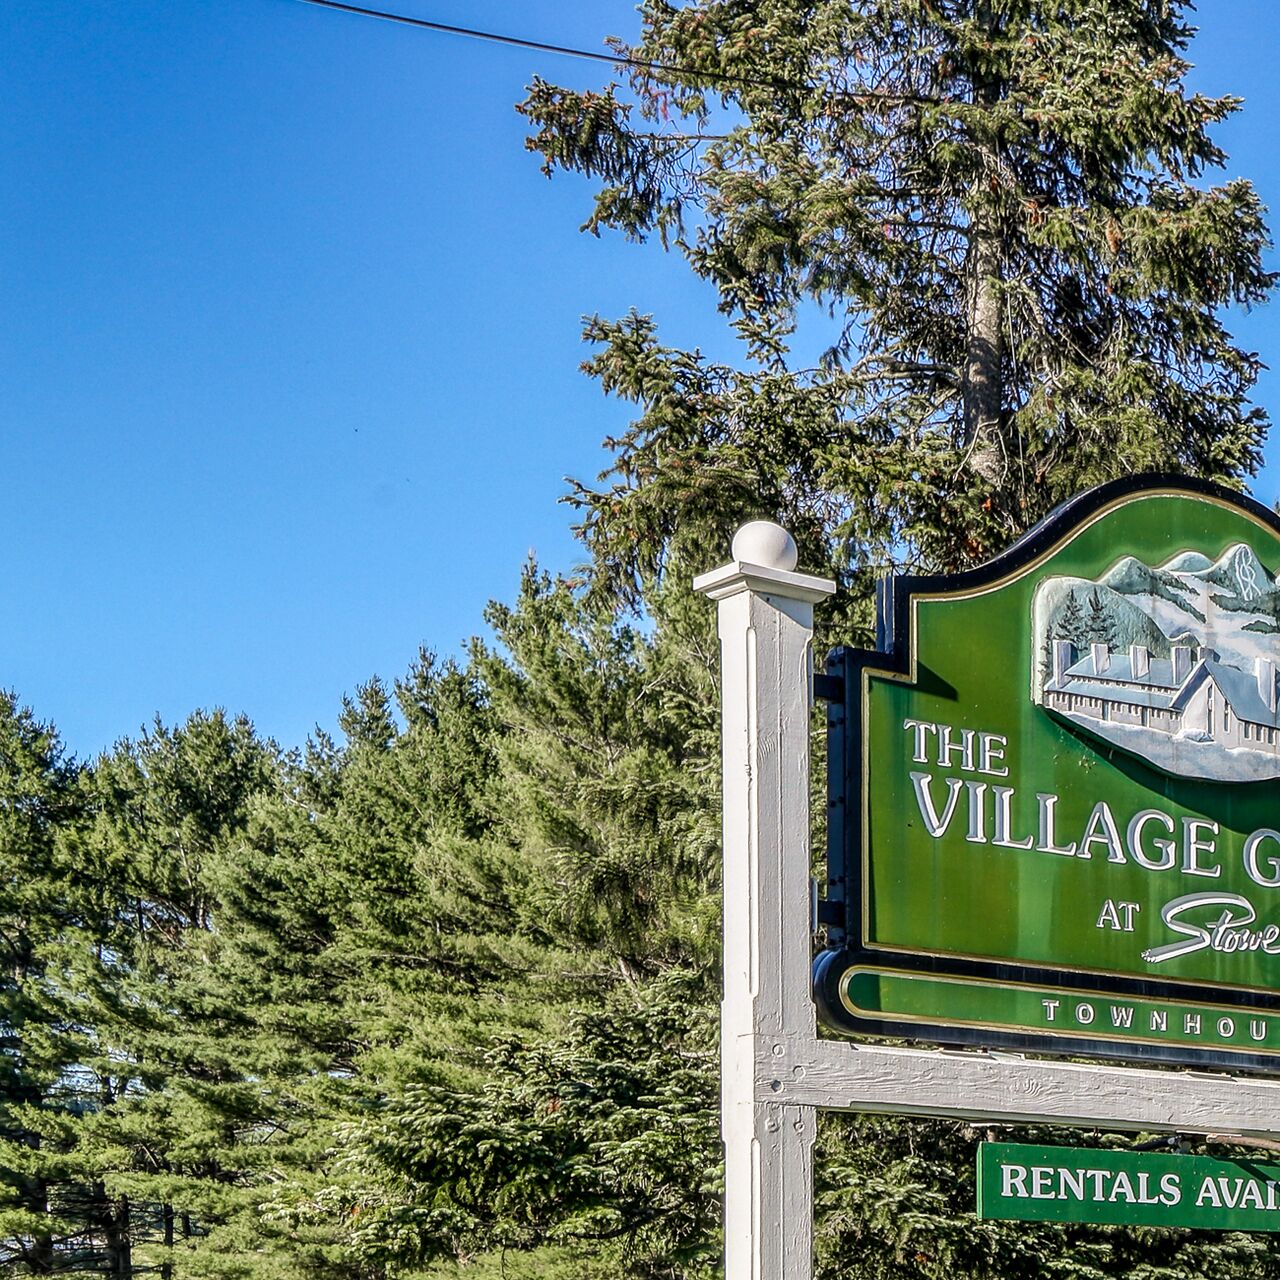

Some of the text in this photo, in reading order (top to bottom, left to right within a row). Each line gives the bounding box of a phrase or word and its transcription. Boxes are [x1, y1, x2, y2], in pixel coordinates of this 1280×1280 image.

[903, 718, 1009, 777] THE
[909, 771, 1222, 877] VILLAGE
[1096, 898, 1140, 932] AT
[1000, 1164, 1182, 1207] RENTALS
